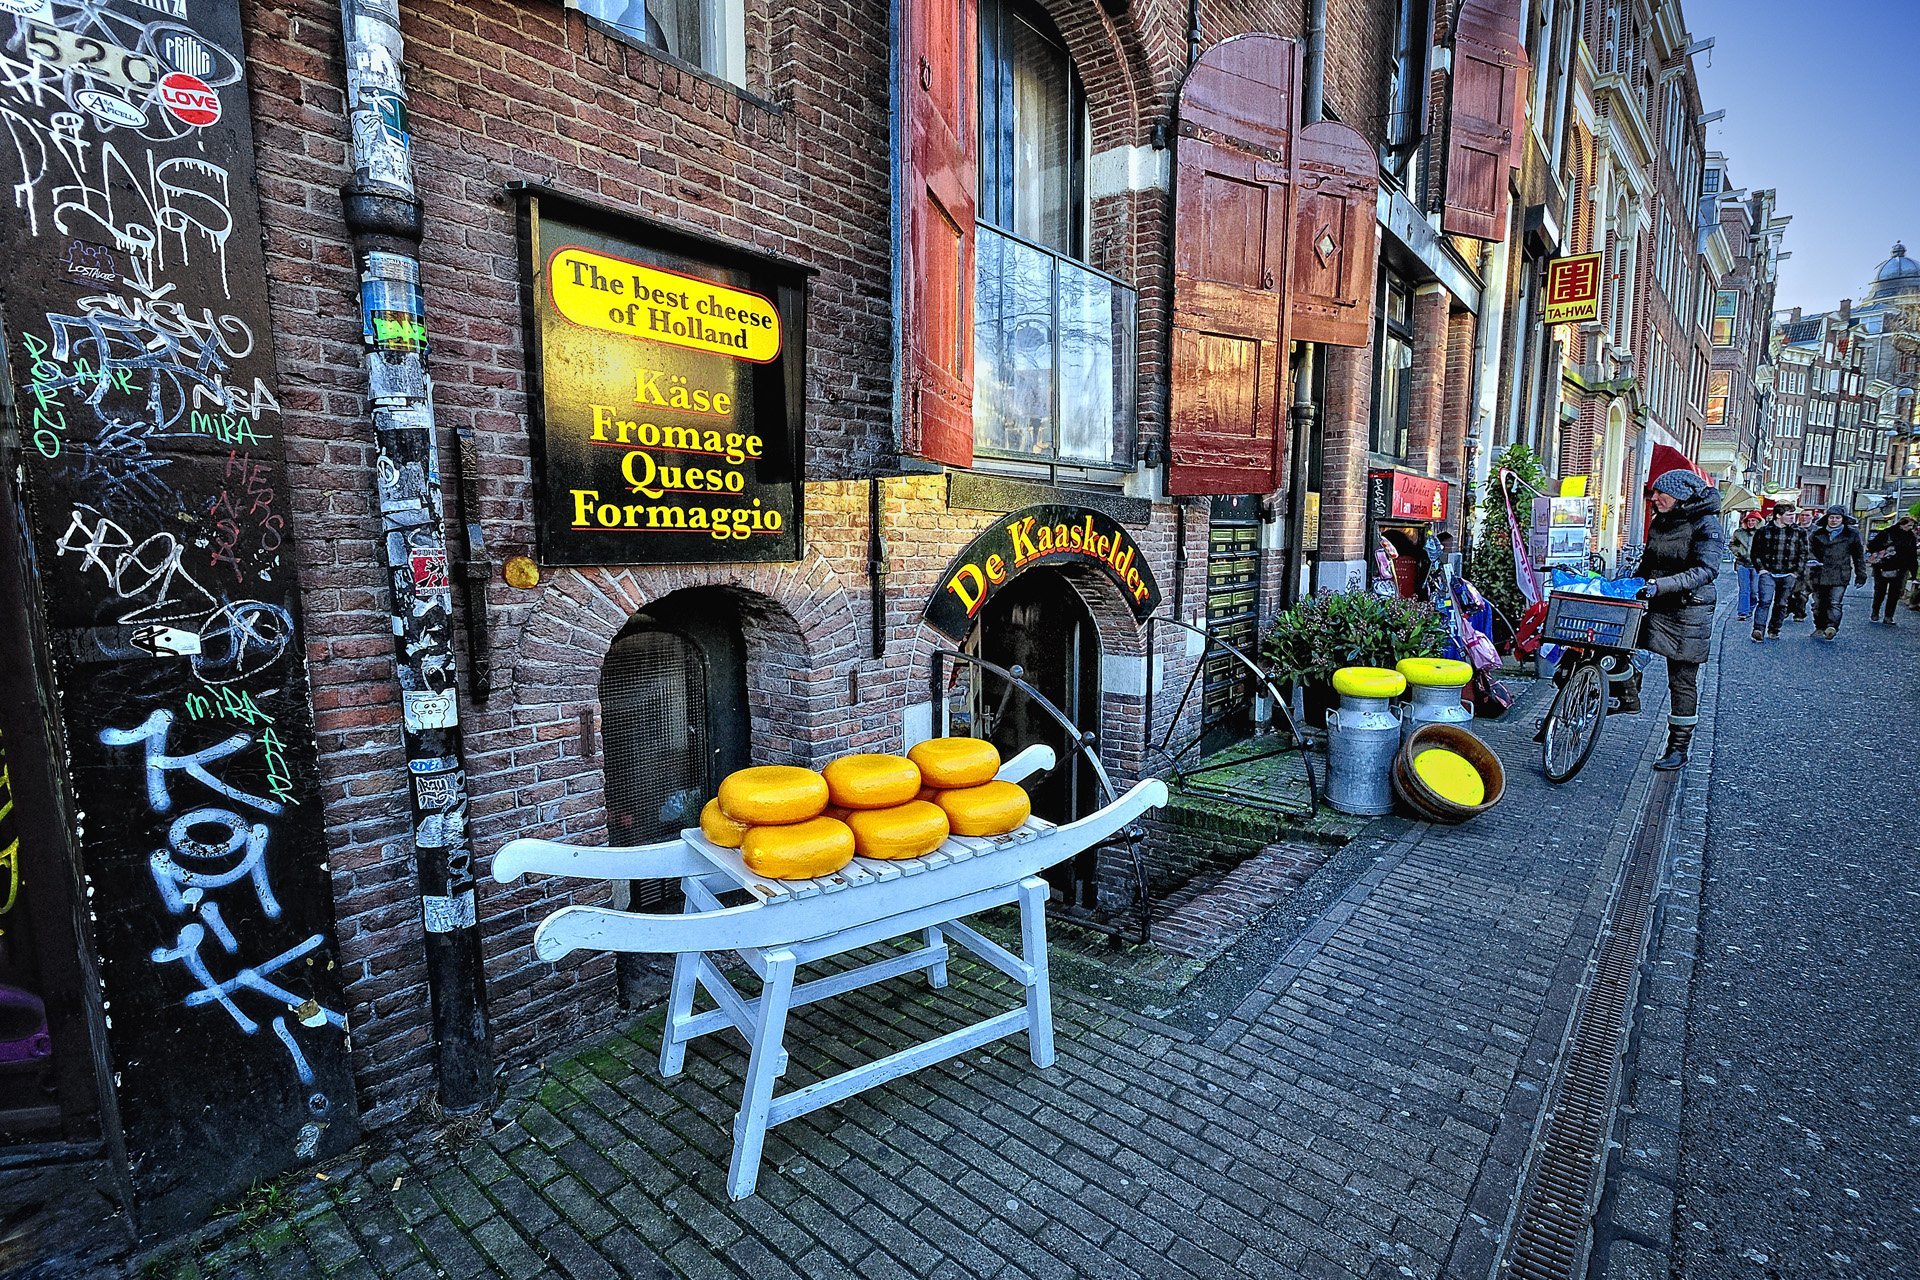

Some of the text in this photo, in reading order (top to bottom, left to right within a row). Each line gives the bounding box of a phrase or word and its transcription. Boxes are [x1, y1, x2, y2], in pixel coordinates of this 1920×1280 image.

[27, 24, 158, 90] 520
[162, 88, 219, 111] LOVE
[566, 258, 773, 330] The best cheese
[1548, 304, 1594, 319] TA-HWA
[608, 303, 748, 349] of Holland
[633, 368, 731, 415] Käse
[588, 404, 763, 465] Fromage
[621, 451, 745, 500] Queso
[570, 489, 782, 540] Formaggio
[947, 515, 1150, 618] De Kaaskelder
